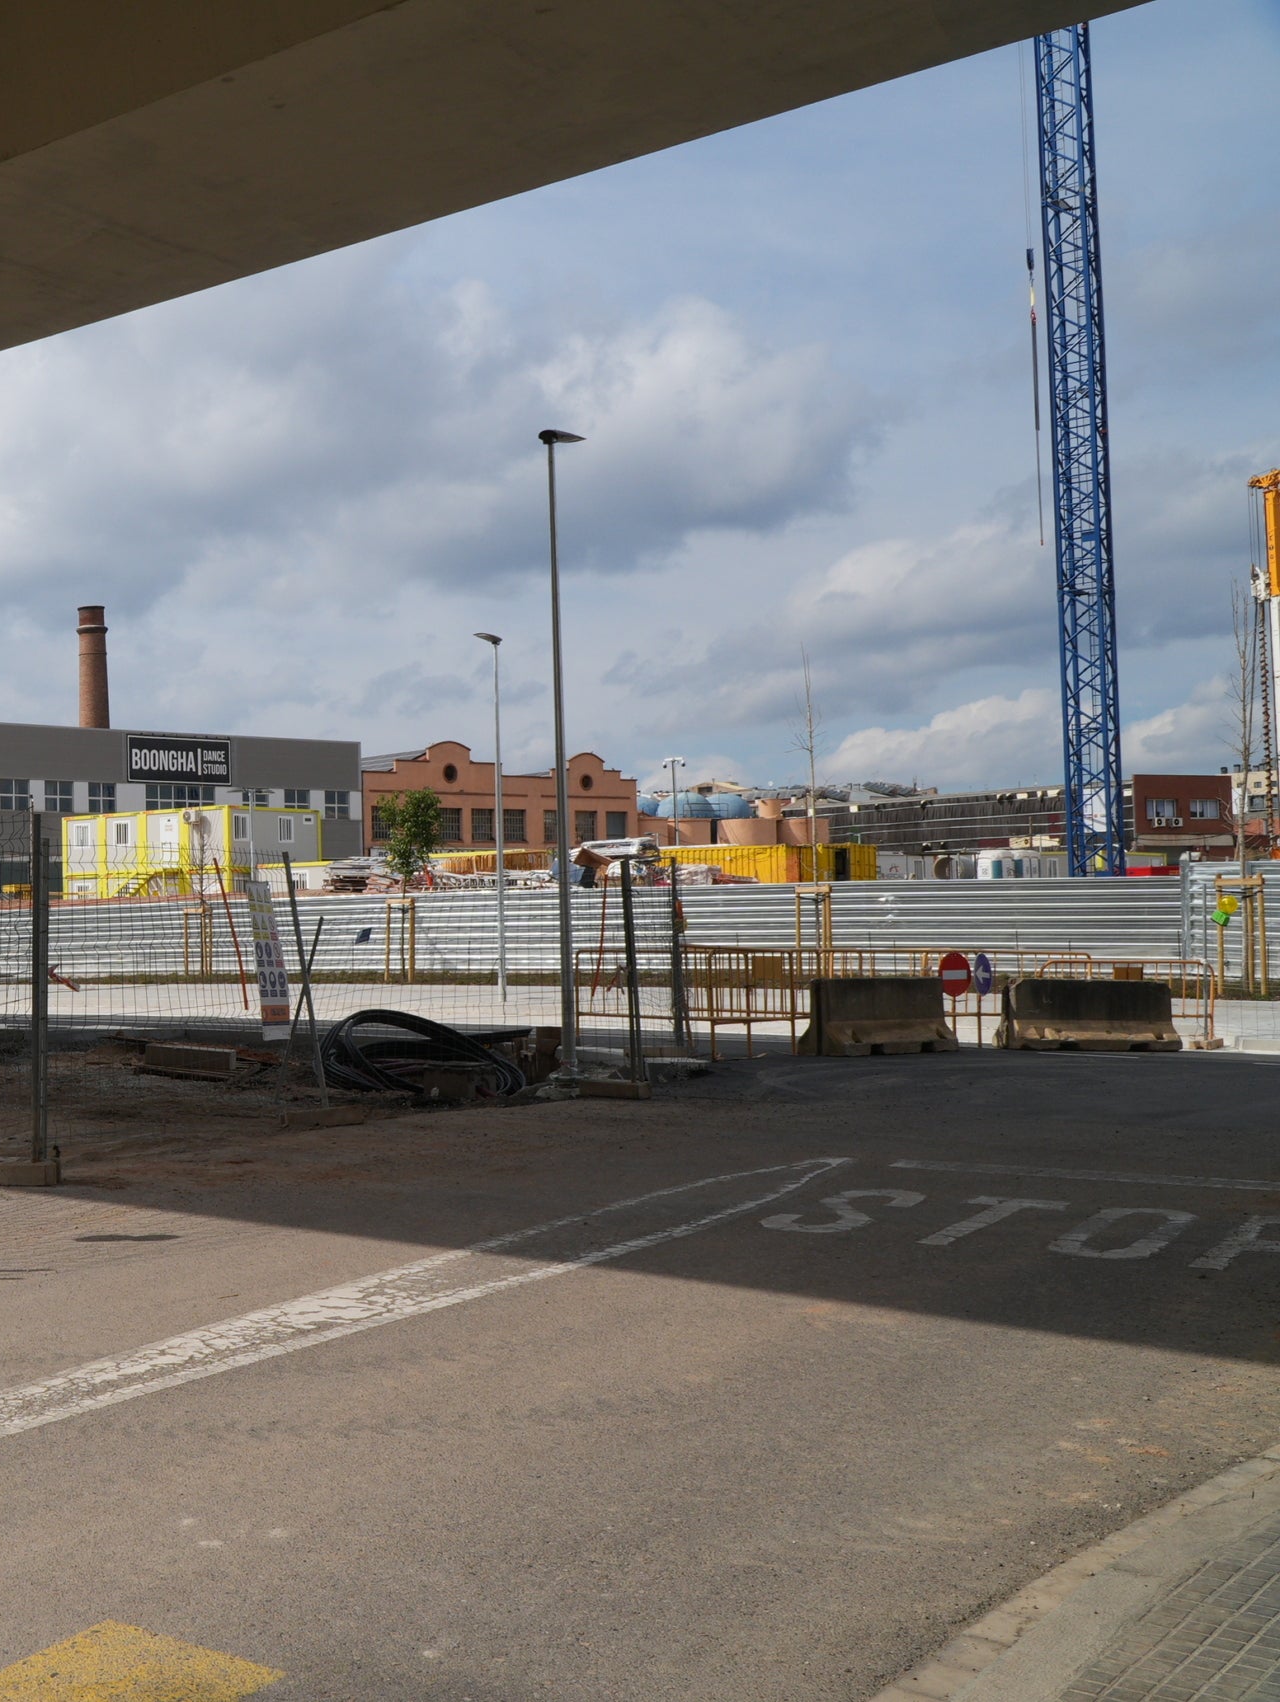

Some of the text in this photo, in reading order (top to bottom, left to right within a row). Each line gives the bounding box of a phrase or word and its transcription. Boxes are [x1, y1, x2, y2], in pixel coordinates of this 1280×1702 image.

[131, 748, 196, 772] BOONGHA
[203, 750, 225, 762] DANCE
[203, 763, 227, 775] STUDIO
